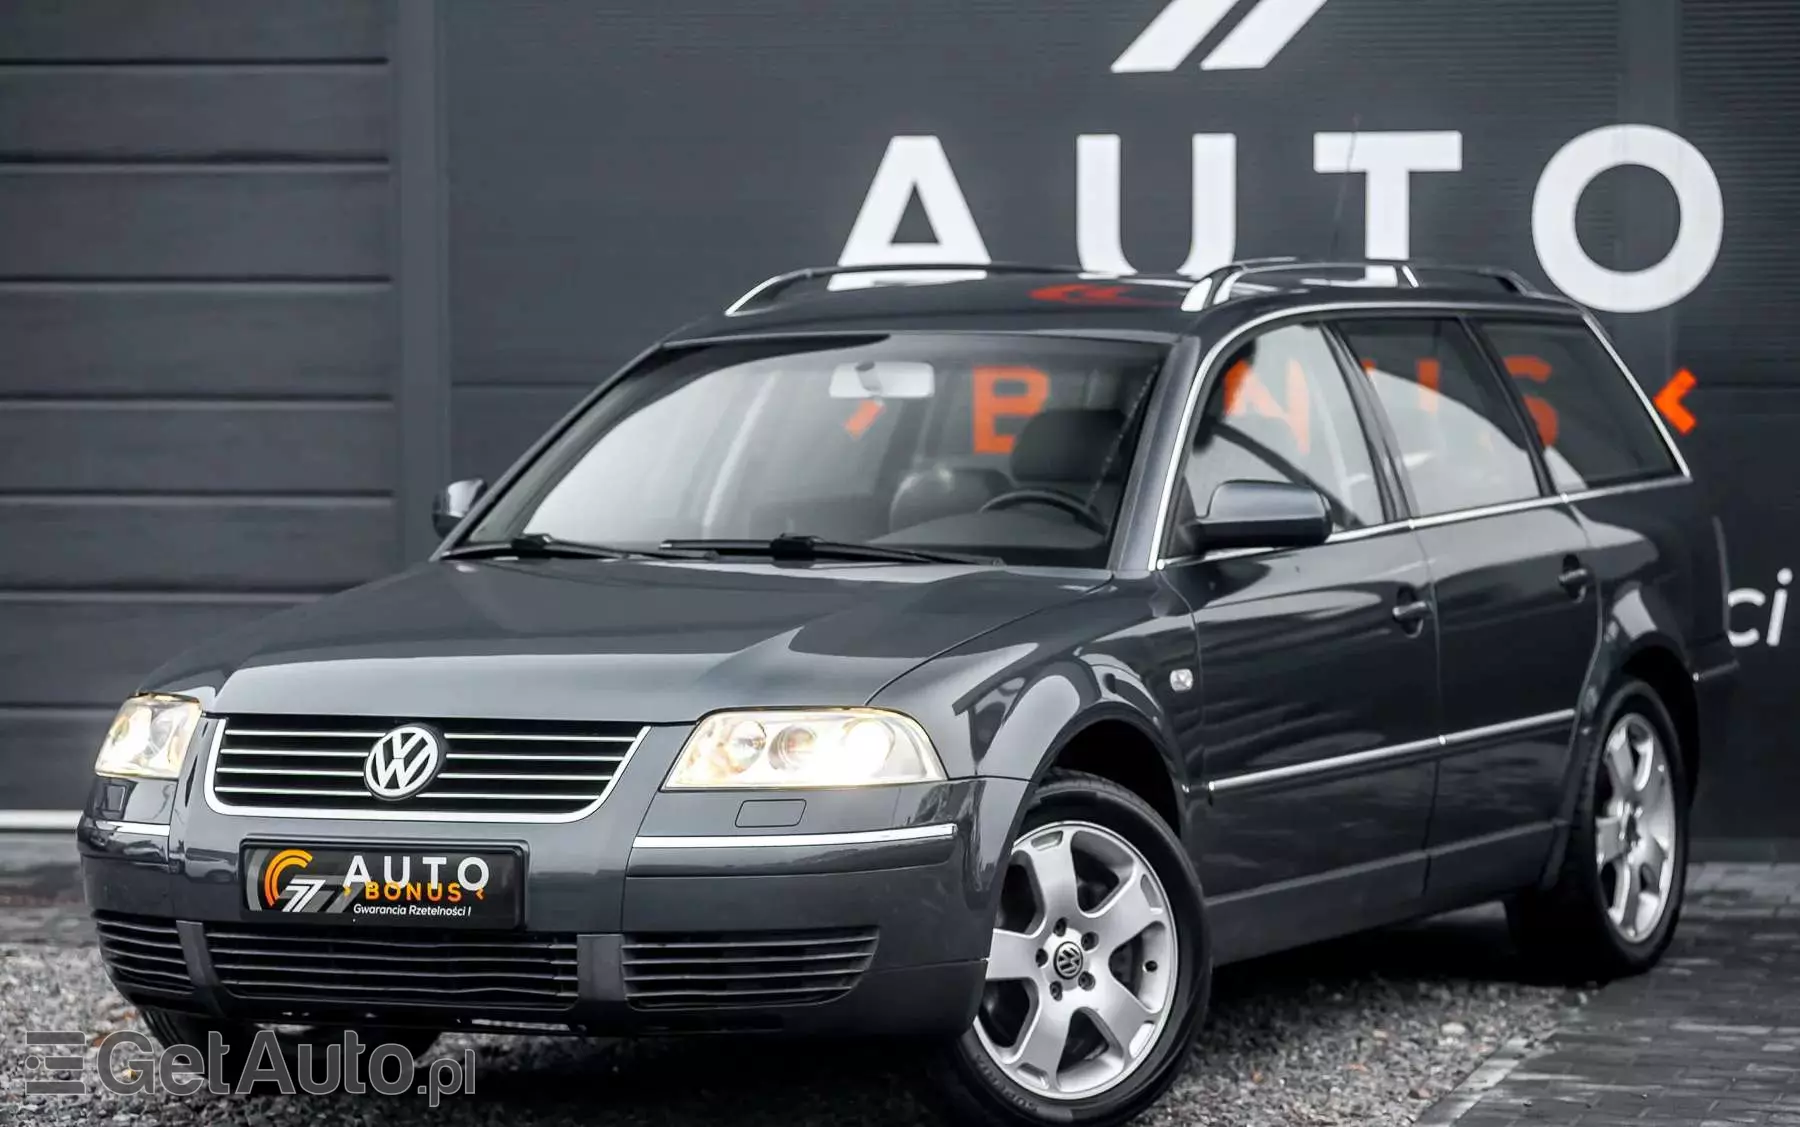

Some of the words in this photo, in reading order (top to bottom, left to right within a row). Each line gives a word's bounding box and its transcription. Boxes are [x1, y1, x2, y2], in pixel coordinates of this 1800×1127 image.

[837, 124, 1724, 312] AUTO
[343, 855, 489, 891] AUTO
[365, 881, 462, 901] BONUS
